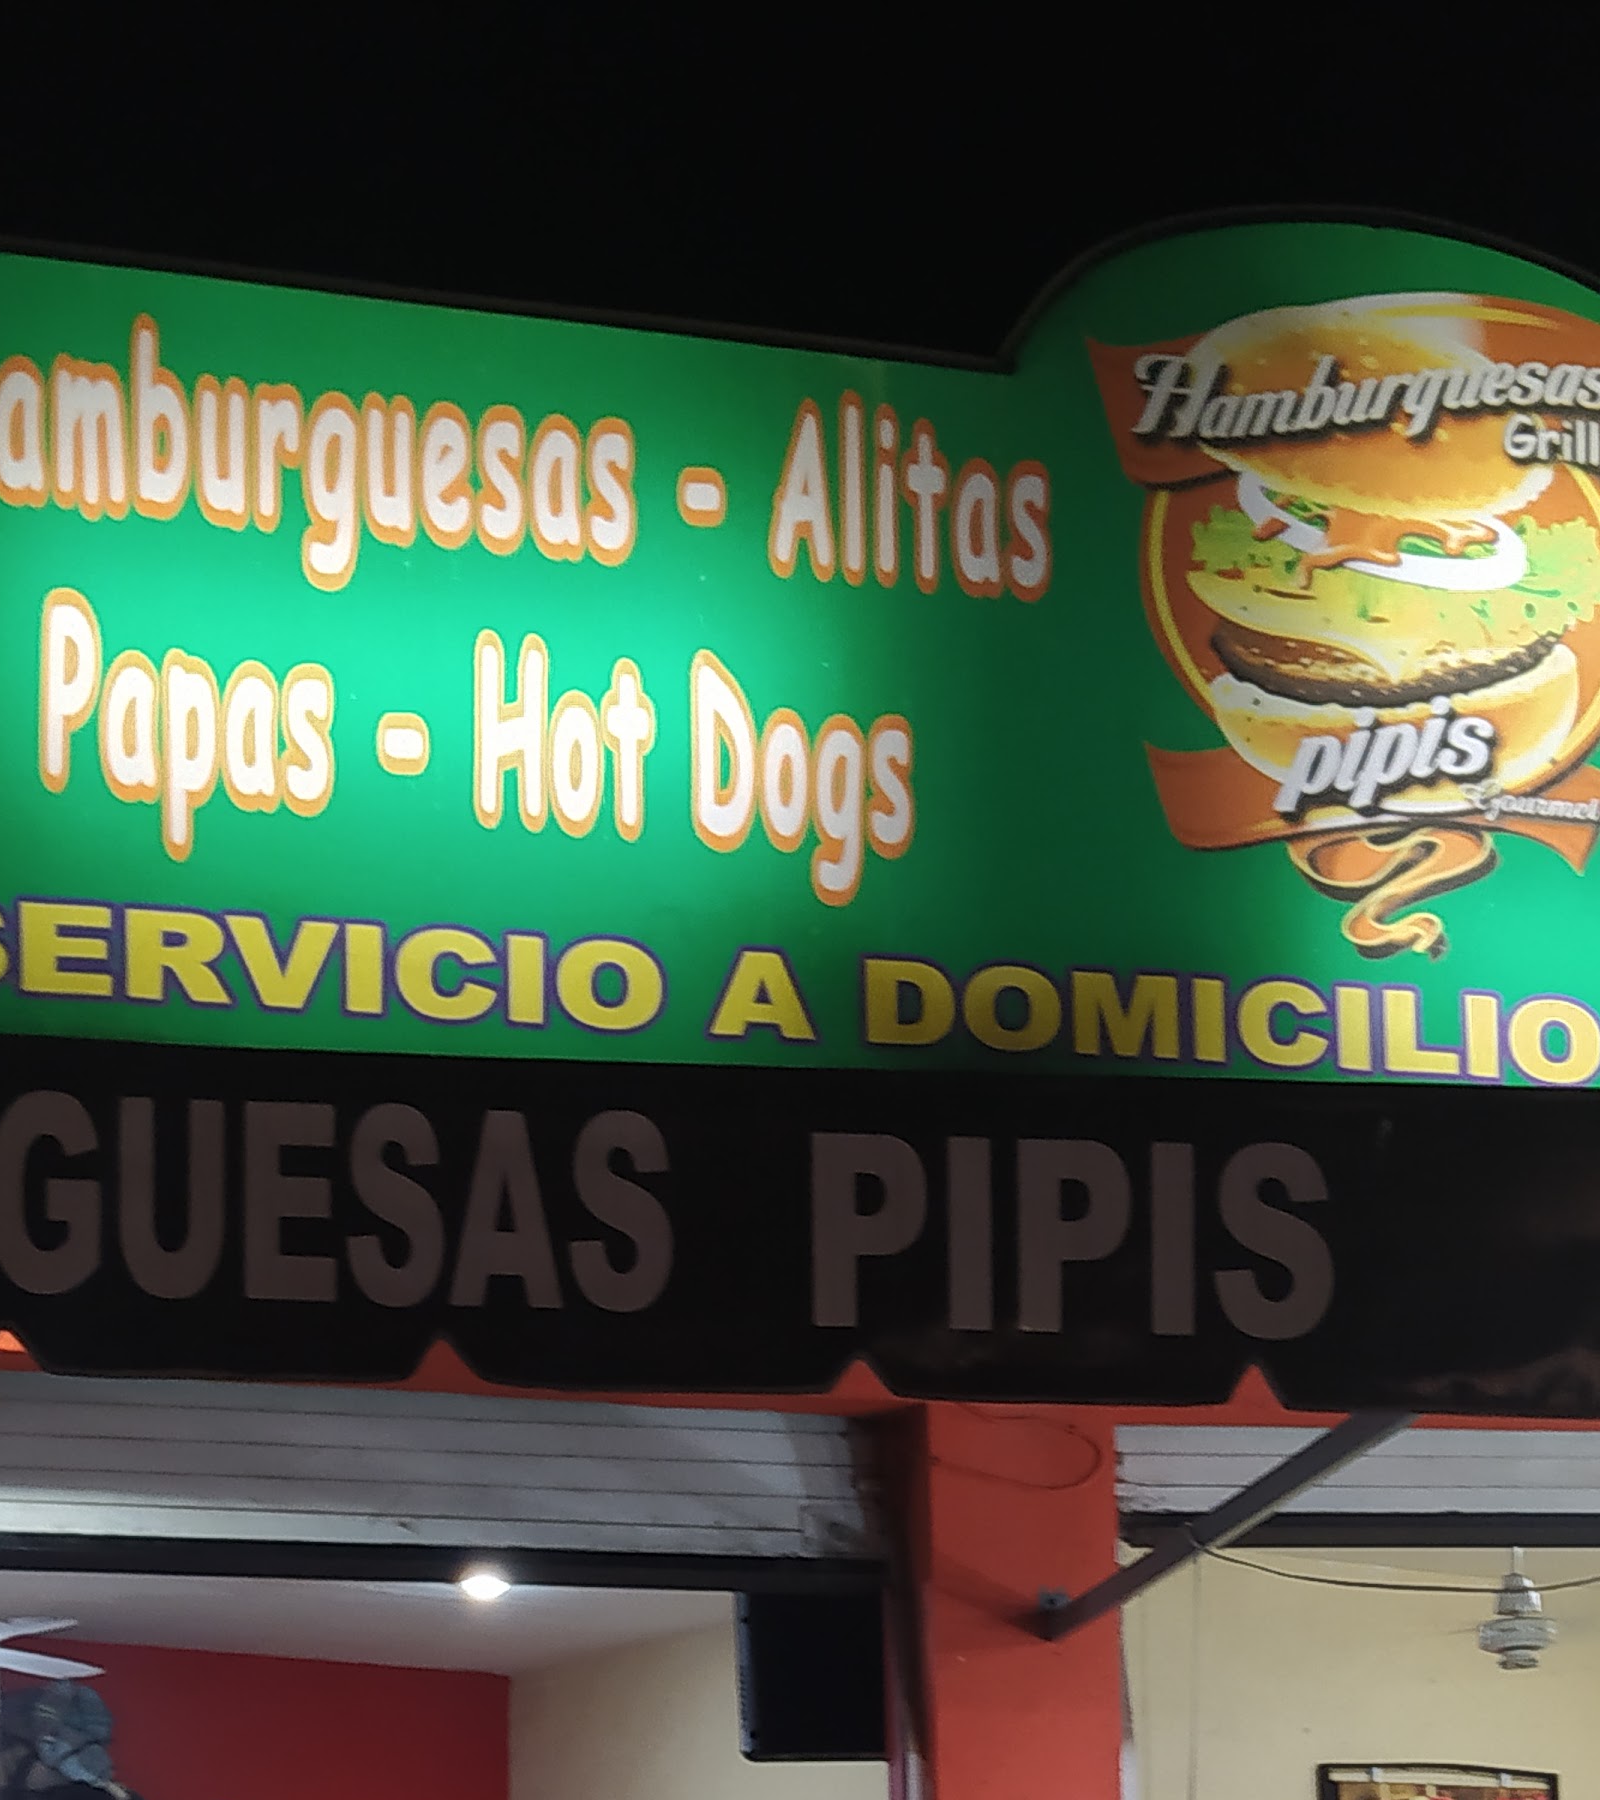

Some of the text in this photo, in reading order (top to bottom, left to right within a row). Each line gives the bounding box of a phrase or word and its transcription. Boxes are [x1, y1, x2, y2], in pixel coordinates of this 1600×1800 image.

[768, 388, 1051, 602] Alitas
[38, 587, 334, 861] Papas
[473, 629, 656, 842] Hot
[690, 648, 915, 907] Dogs
[1272, 694, 1498, 817] pipis
[707, 950, 819, 1042] A
[811, 1132, 1335, 1340] PIPIS
